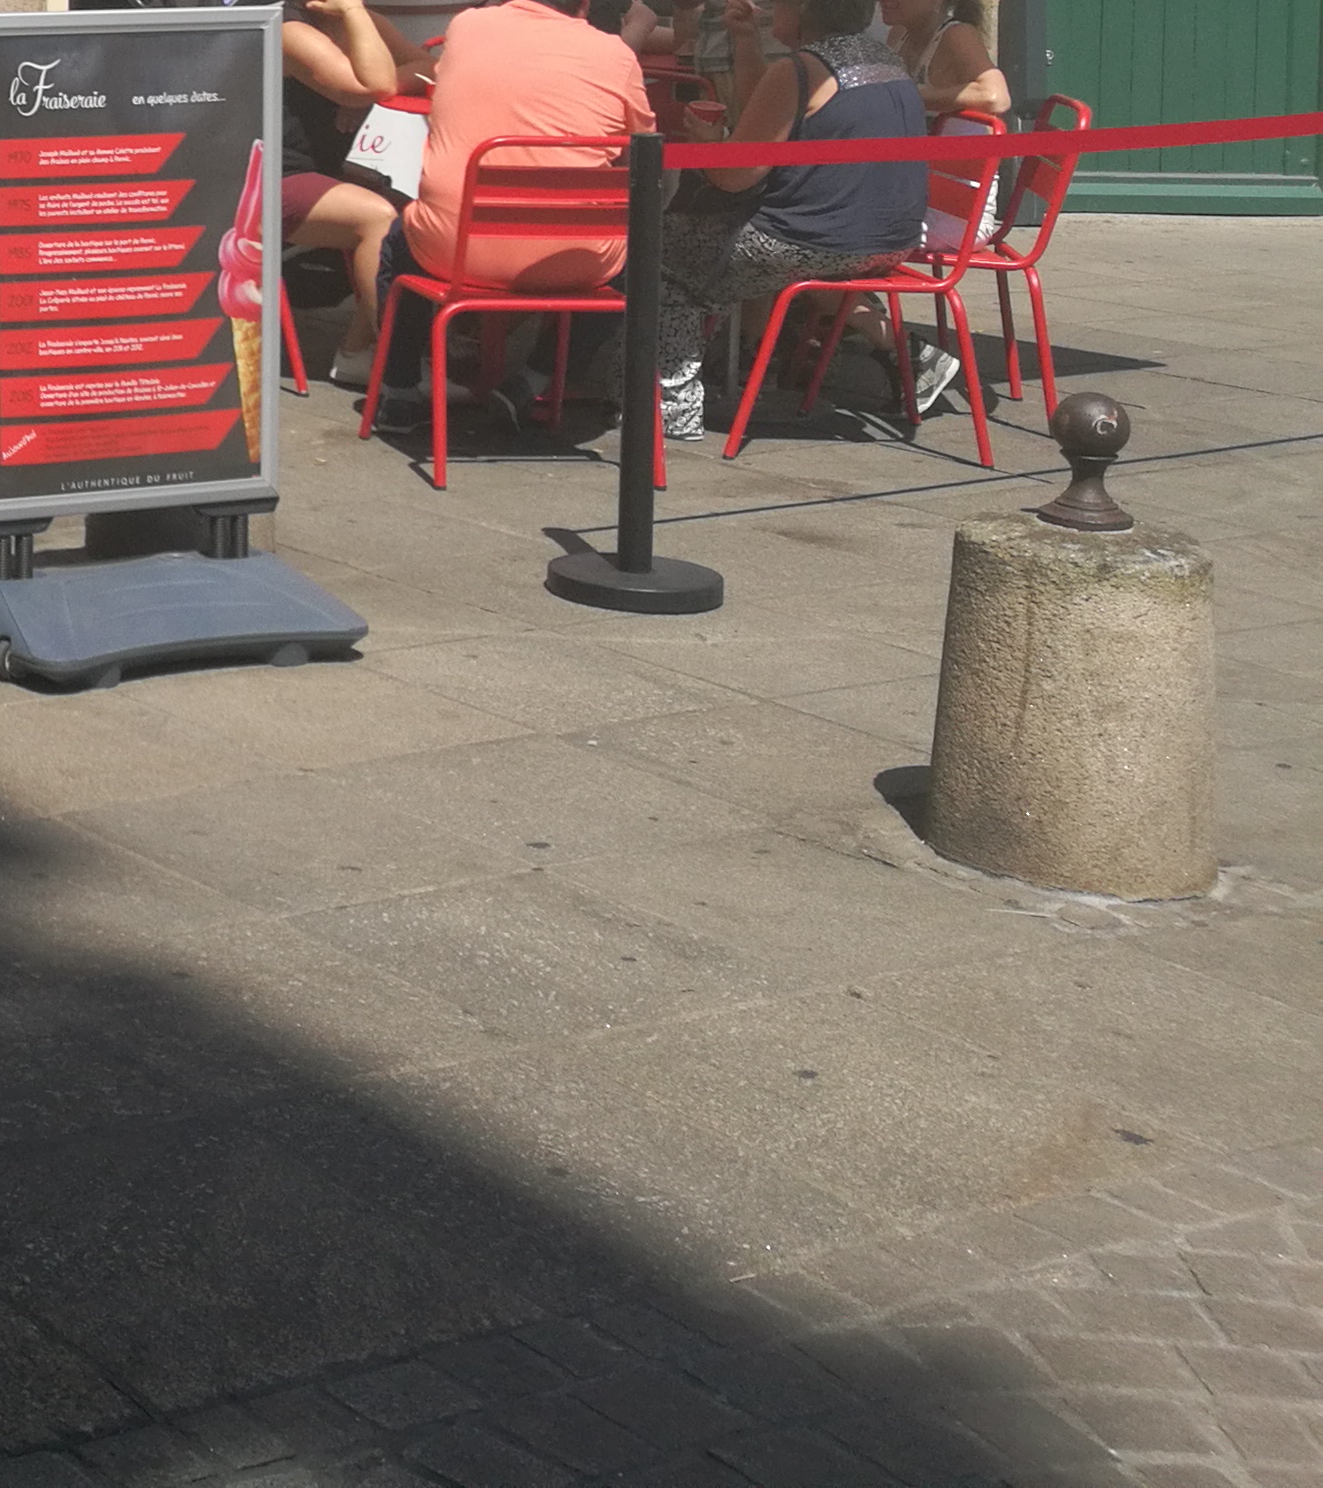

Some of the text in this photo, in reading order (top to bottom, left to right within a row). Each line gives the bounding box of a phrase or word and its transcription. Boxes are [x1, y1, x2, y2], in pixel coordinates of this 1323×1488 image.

[9, 59, 107, 117] la Fraiseraie
[132, 95, 145, 105] en
[146, 91, 189, 107] quelques
[61, 471, 195, 491] L'AUTHENTIQUE DU FRUIT
